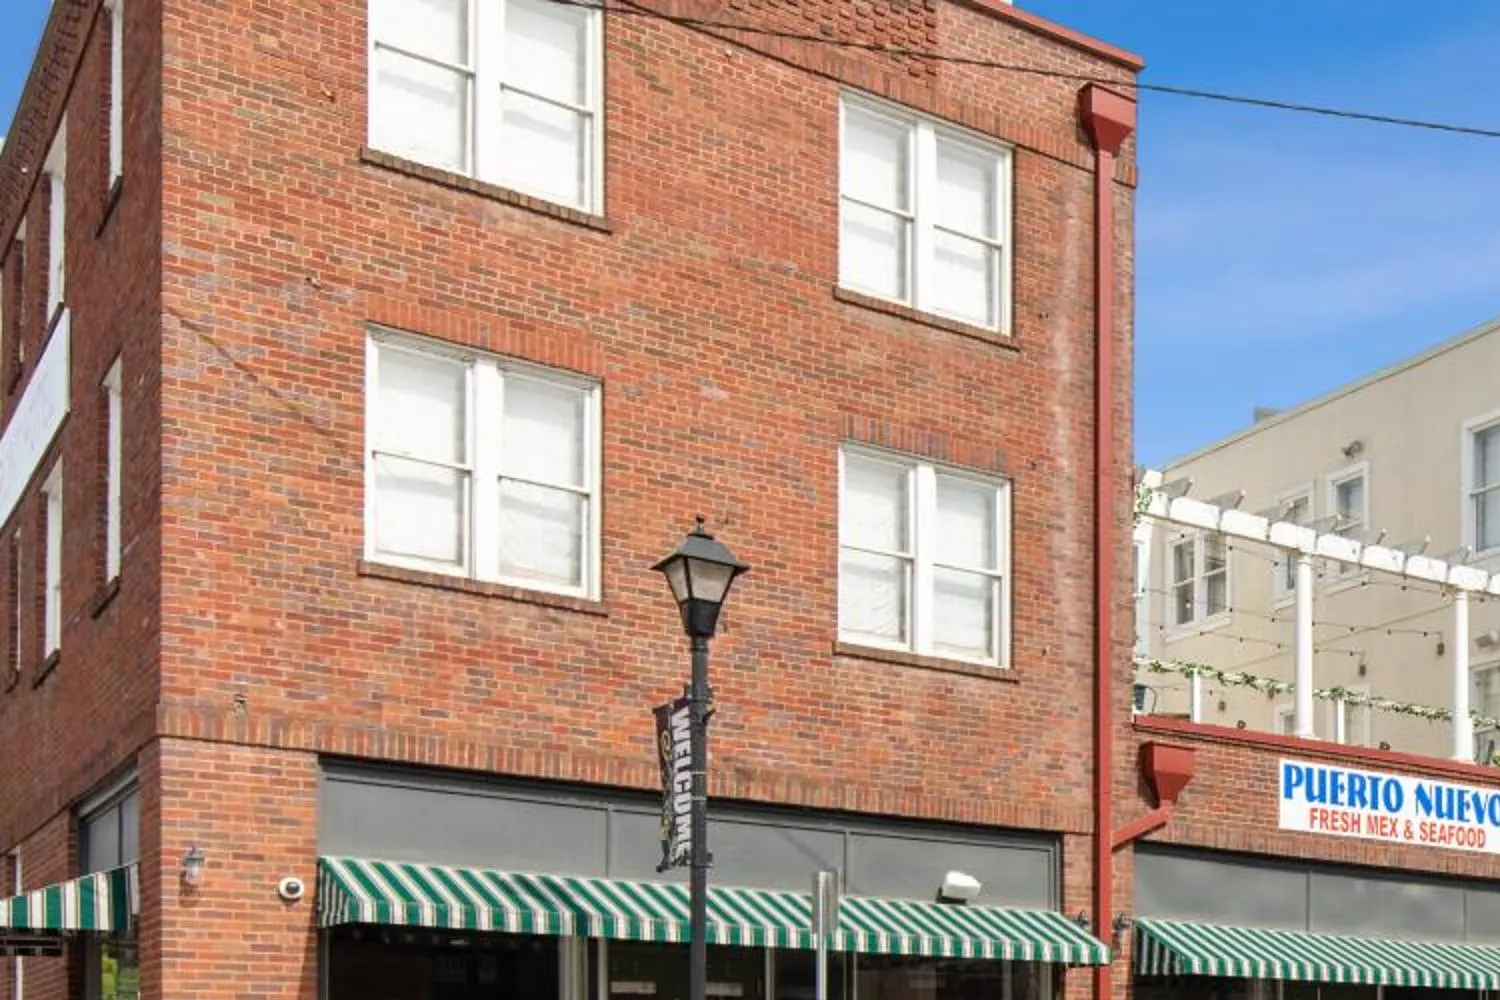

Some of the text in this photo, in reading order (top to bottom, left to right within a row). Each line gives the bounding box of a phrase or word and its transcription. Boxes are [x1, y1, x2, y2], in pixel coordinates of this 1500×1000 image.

[671, 705, 692, 864] WELCOME
[1283, 763, 1404, 813] PUERTO
[1309, 807, 1486, 849] FRESH MEX & SEAFOOD
